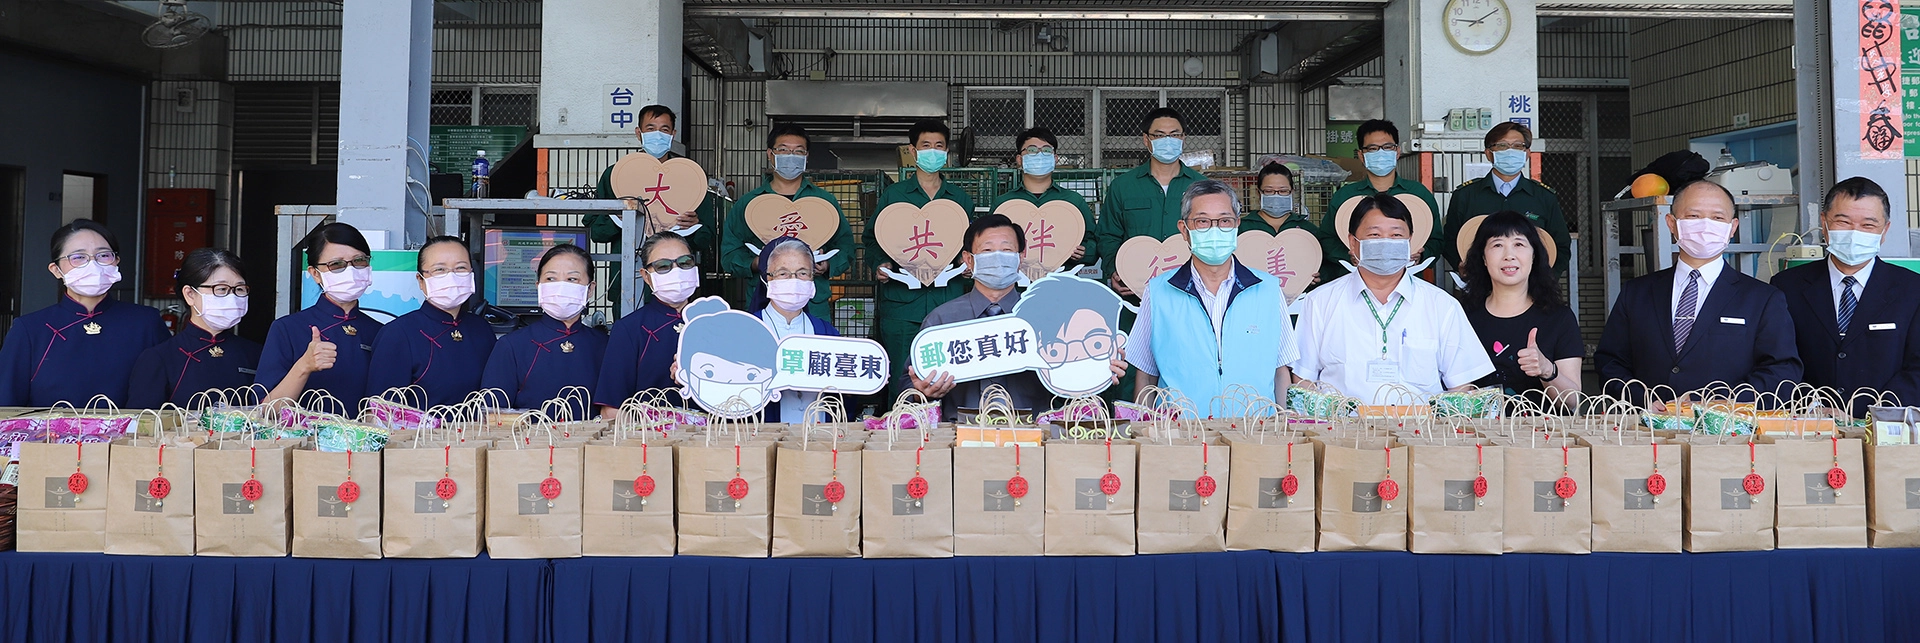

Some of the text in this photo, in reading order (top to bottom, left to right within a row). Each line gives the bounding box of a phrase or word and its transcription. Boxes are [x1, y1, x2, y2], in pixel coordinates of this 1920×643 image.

[1451, 18, 1457, 26] 9
[1455, 29, 1460, 37] 8
[1496, 18, 1502, 26] 3
[610, 87, 634, 128] 台中
[645, 173, 680, 215] 大
[175, 232, 184, 271] 消防
[903, 219, 943, 262] 共
[1023, 219, 1056, 263] 伴
[1267, 247, 1296, 288] 善
[781, 348, 883, 380] 罩顧臺東
[919, 329, 1029, 370] 郵您真好
